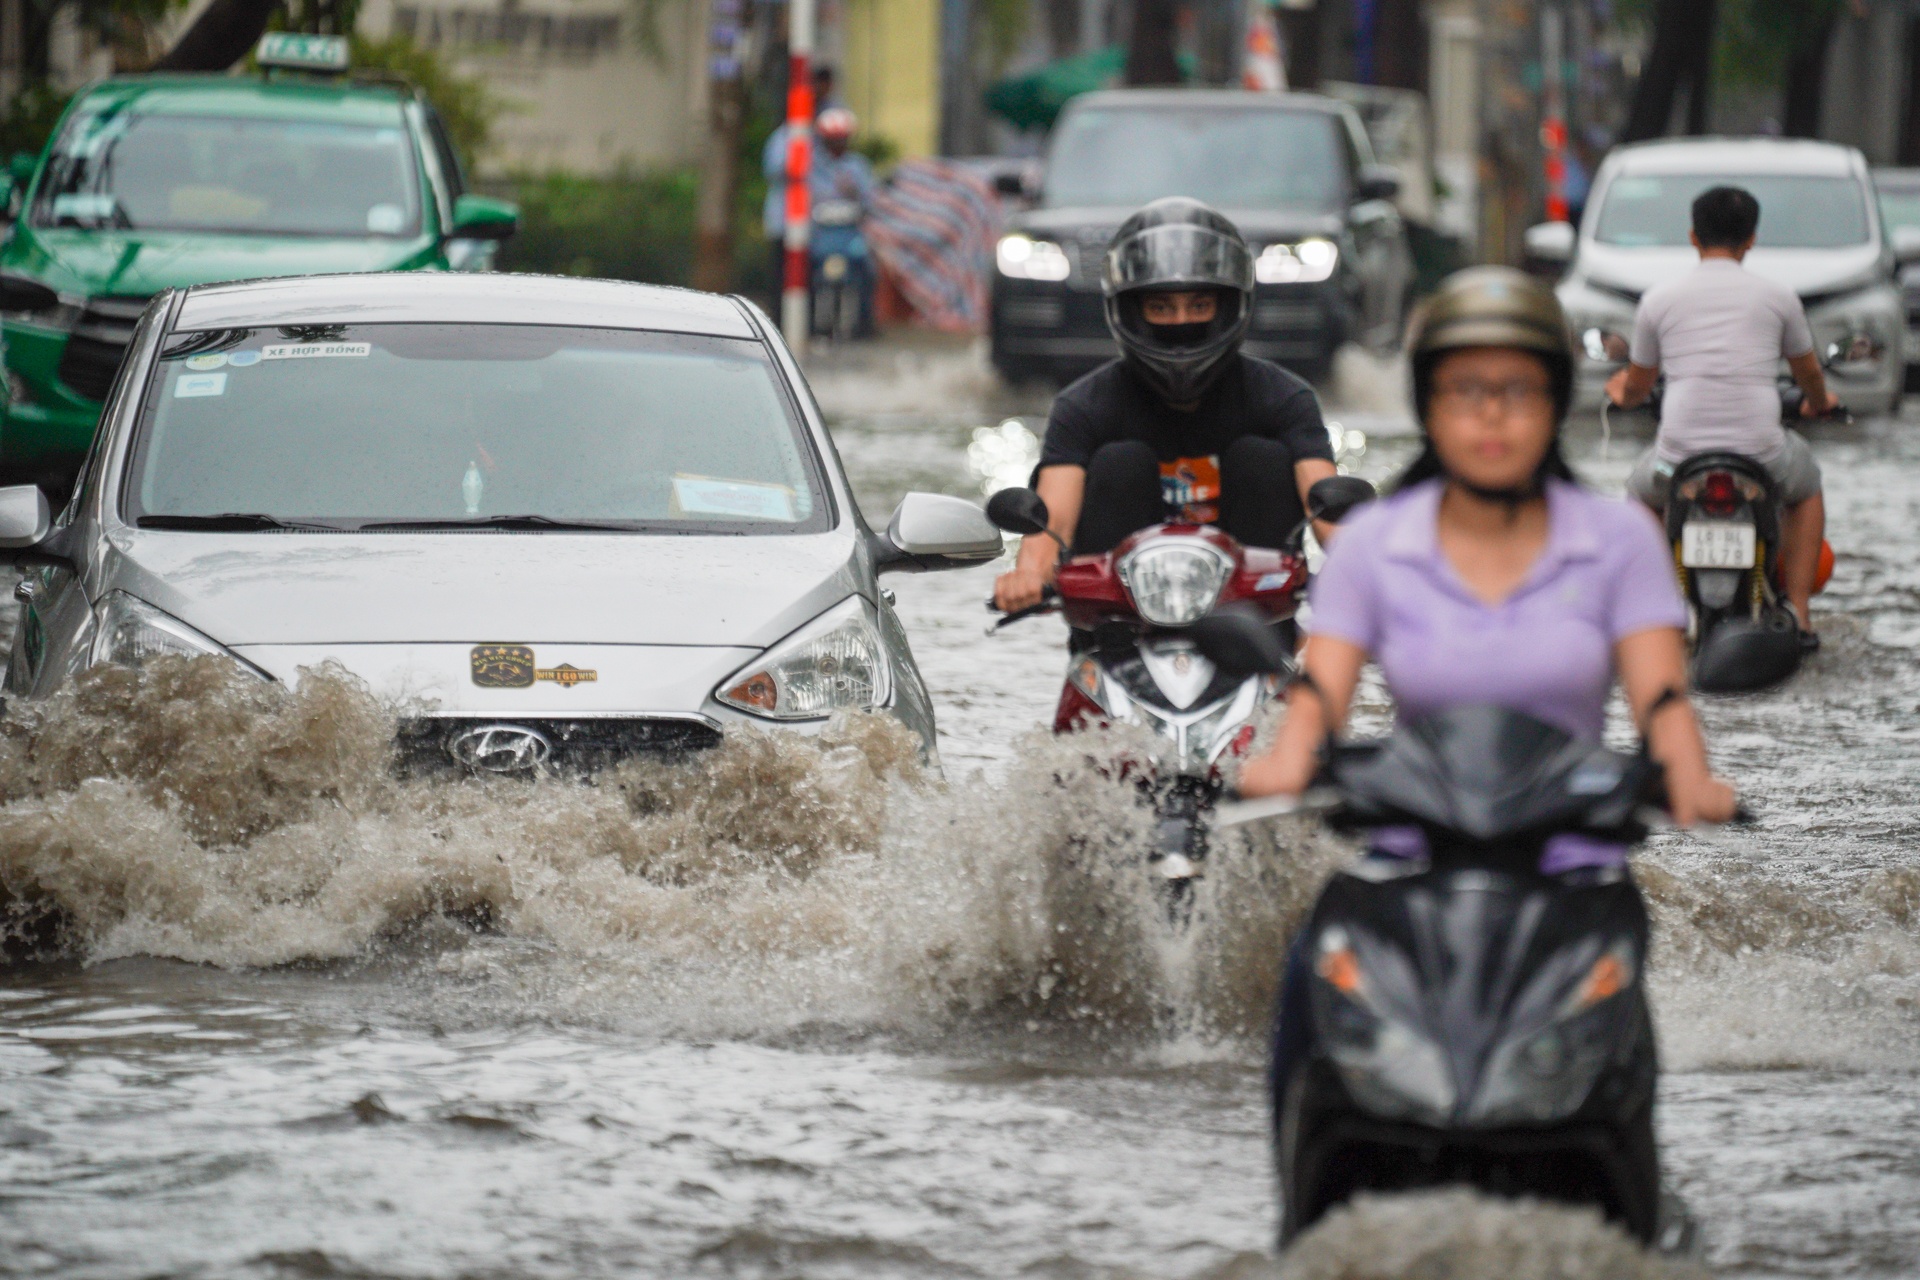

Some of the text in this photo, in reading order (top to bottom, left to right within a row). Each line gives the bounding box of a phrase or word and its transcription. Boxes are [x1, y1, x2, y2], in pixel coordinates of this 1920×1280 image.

[263, 36, 338, 62] TAXI
[268, 348, 287, 357] XE
[536, 671, 555, 680] WIN
[578, 671, 596, 680] WIN
